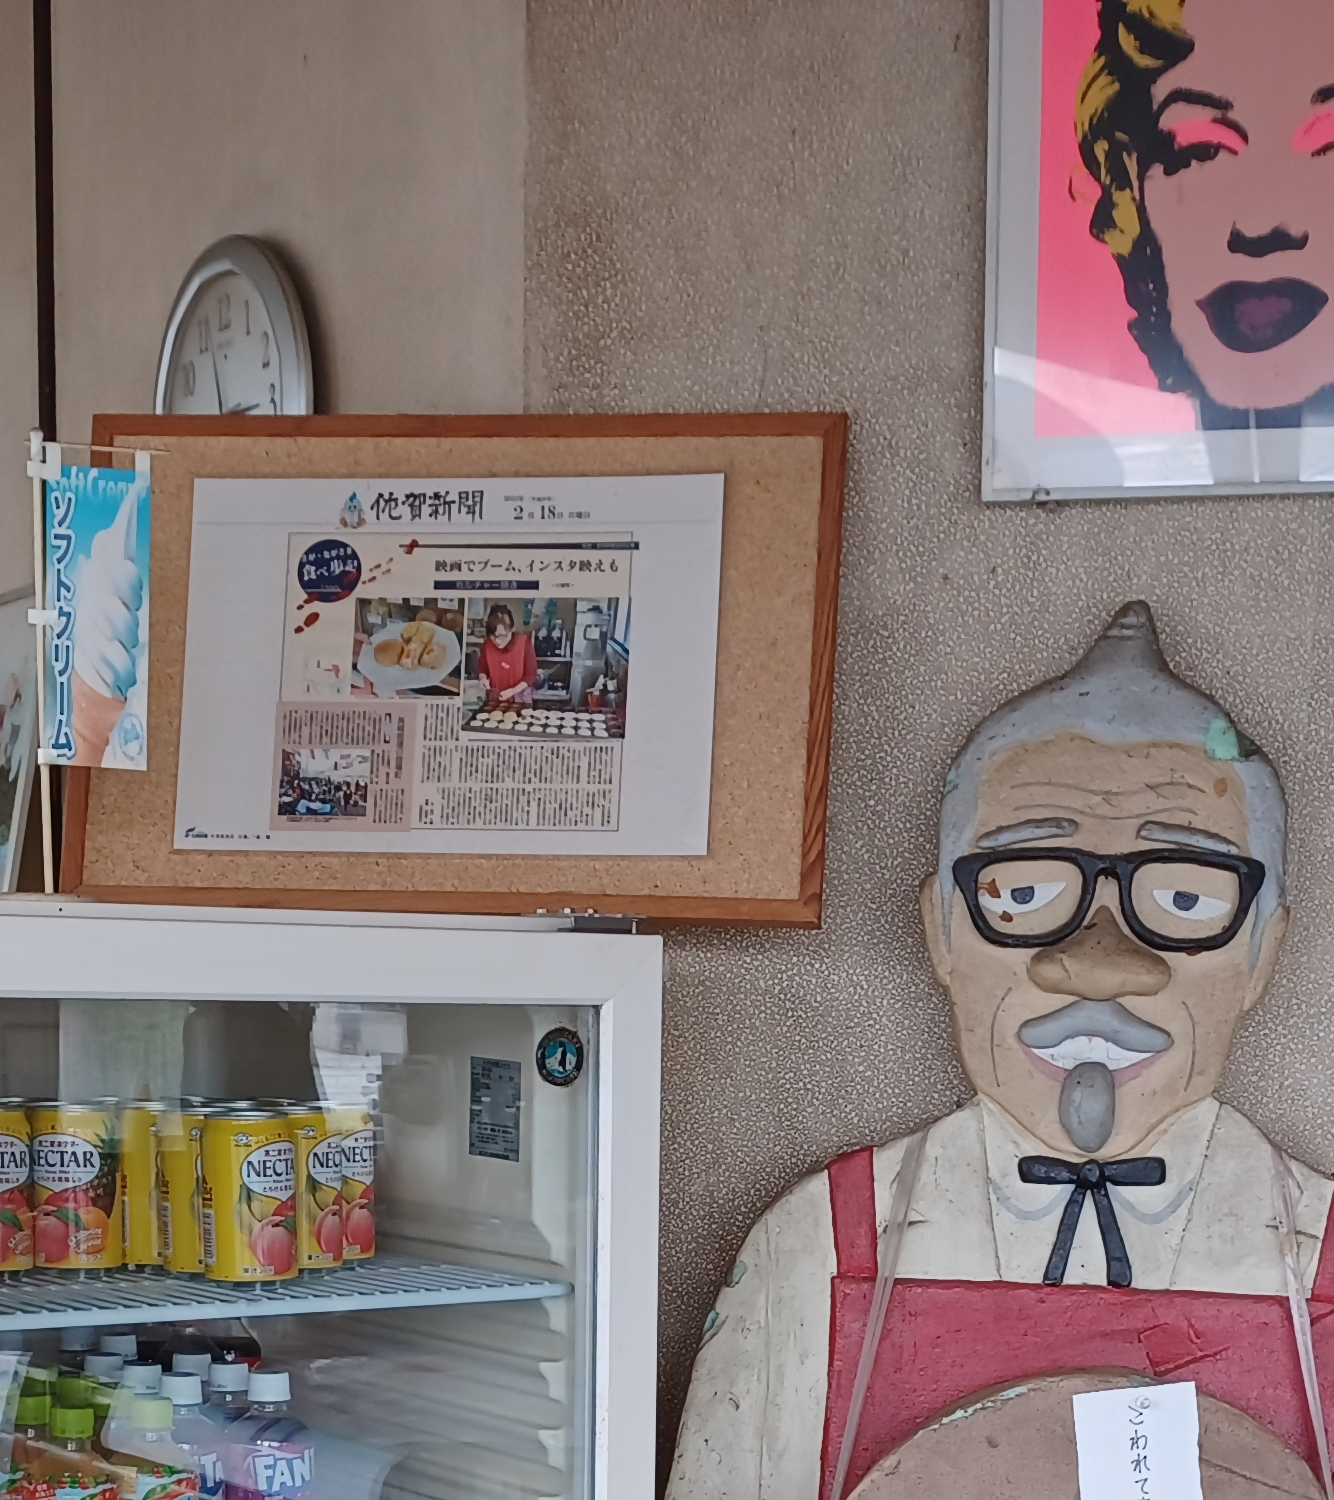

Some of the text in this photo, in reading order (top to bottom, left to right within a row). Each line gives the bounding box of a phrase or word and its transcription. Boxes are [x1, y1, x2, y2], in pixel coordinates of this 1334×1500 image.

[370, 489, 485, 522] 佐賀新聞
[51, 490, 76, 761] ソフトクリーム
[254, 1447, 315, 1492] FAN
